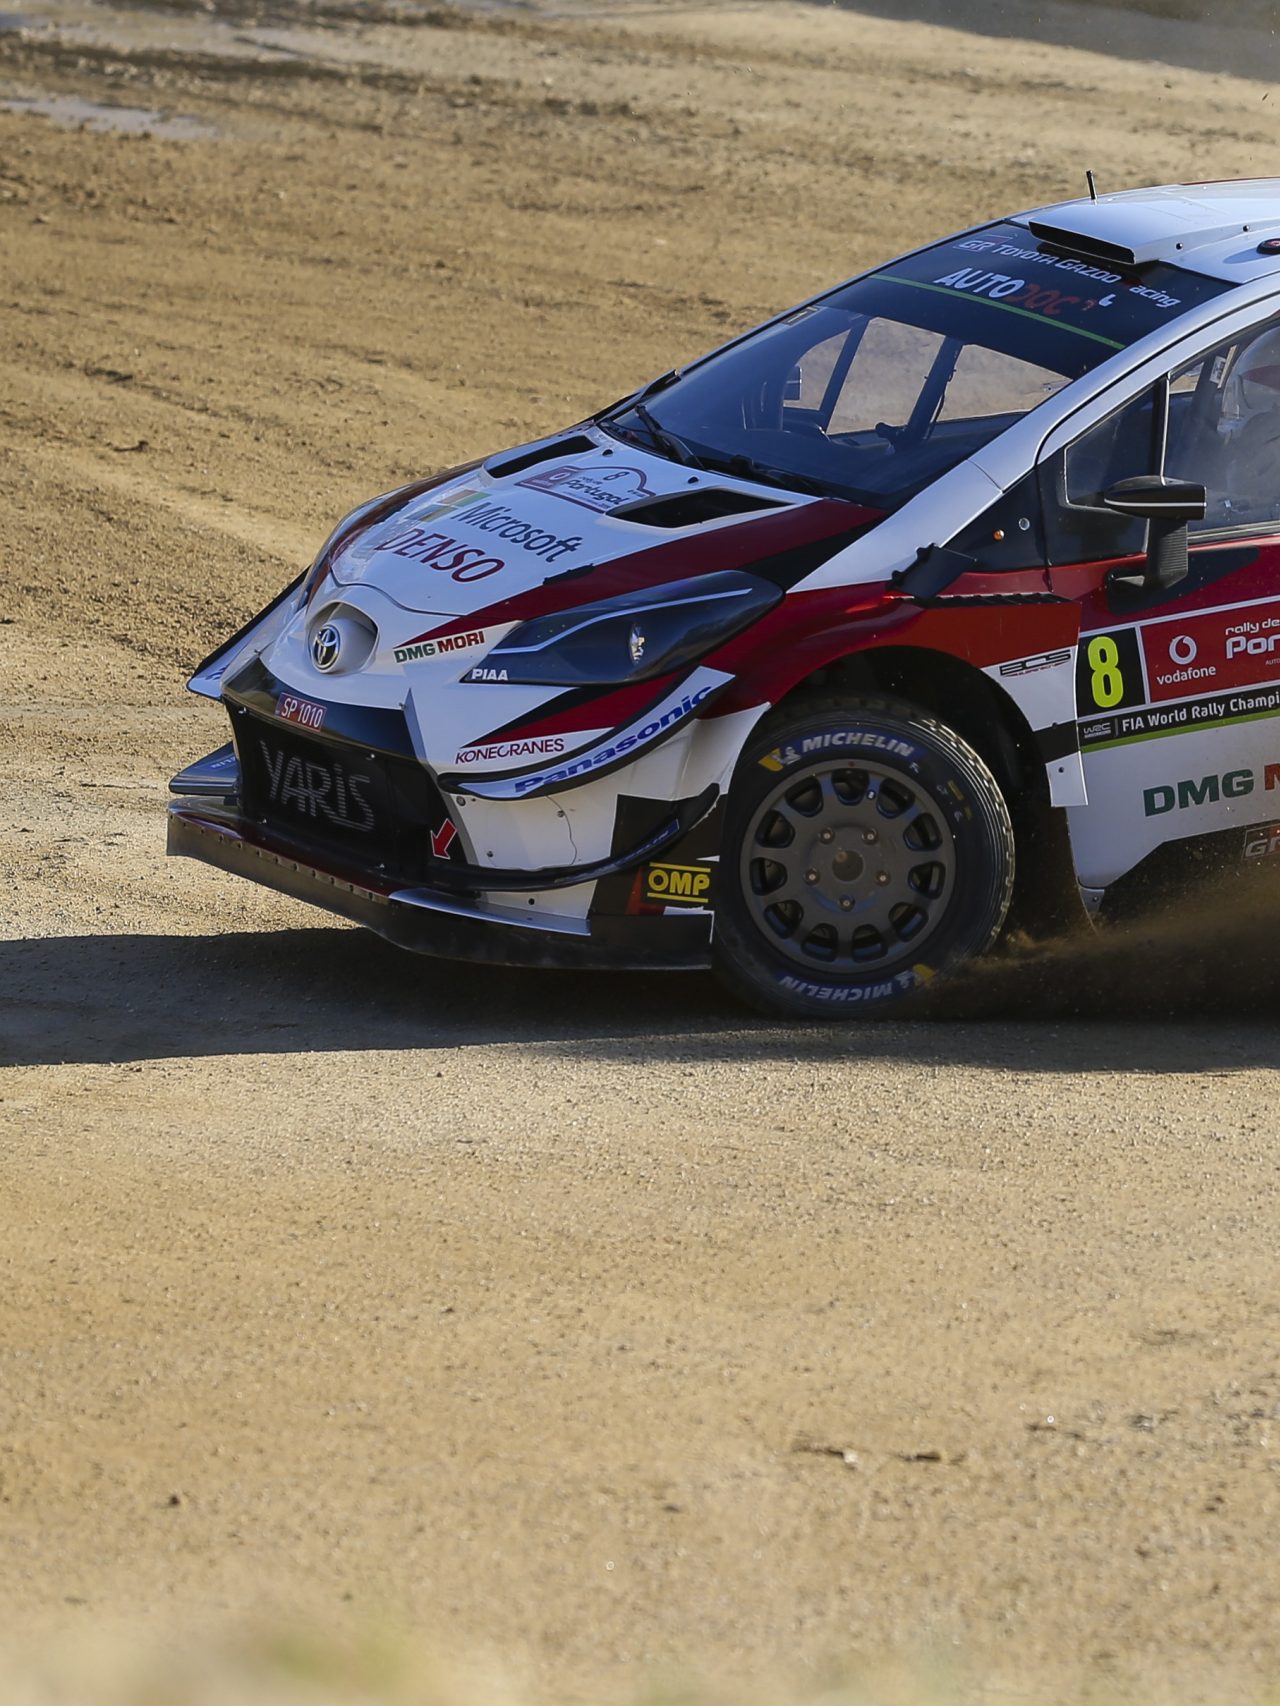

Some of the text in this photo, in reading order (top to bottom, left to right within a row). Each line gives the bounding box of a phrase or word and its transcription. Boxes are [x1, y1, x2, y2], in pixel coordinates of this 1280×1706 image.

[991, 244, 1061, 265] TOYOTA
[1056, 258, 1123, 285] GAZOO
[1124, 283, 1182, 309] acing
[451, 501, 585, 564] Microsoft
[374, 528, 506, 583] DENSO
[1225, 618, 1280, 636] rally de
[394, 631, 486, 664] DMG MORI
[471, 668, 509, 682] PIAA
[1087, 635, 1124, 708] 8
[1156, 665, 1216, 686] vodafone
[280, 697, 325, 729] SP 1010
[1122, 719, 1145, 733] FIA
[1148, 709, 1187, 727] World
[1191, 702, 1226, 720] Rally
[454, 737, 565, 764] KONECRANES
[802, 731, 916, 758] MICHELIN
[1143, 769, 1254, 817] DMG
[648, 868, 710, 897] OMP
[778, 974, 894, 1002] MICHELIN
